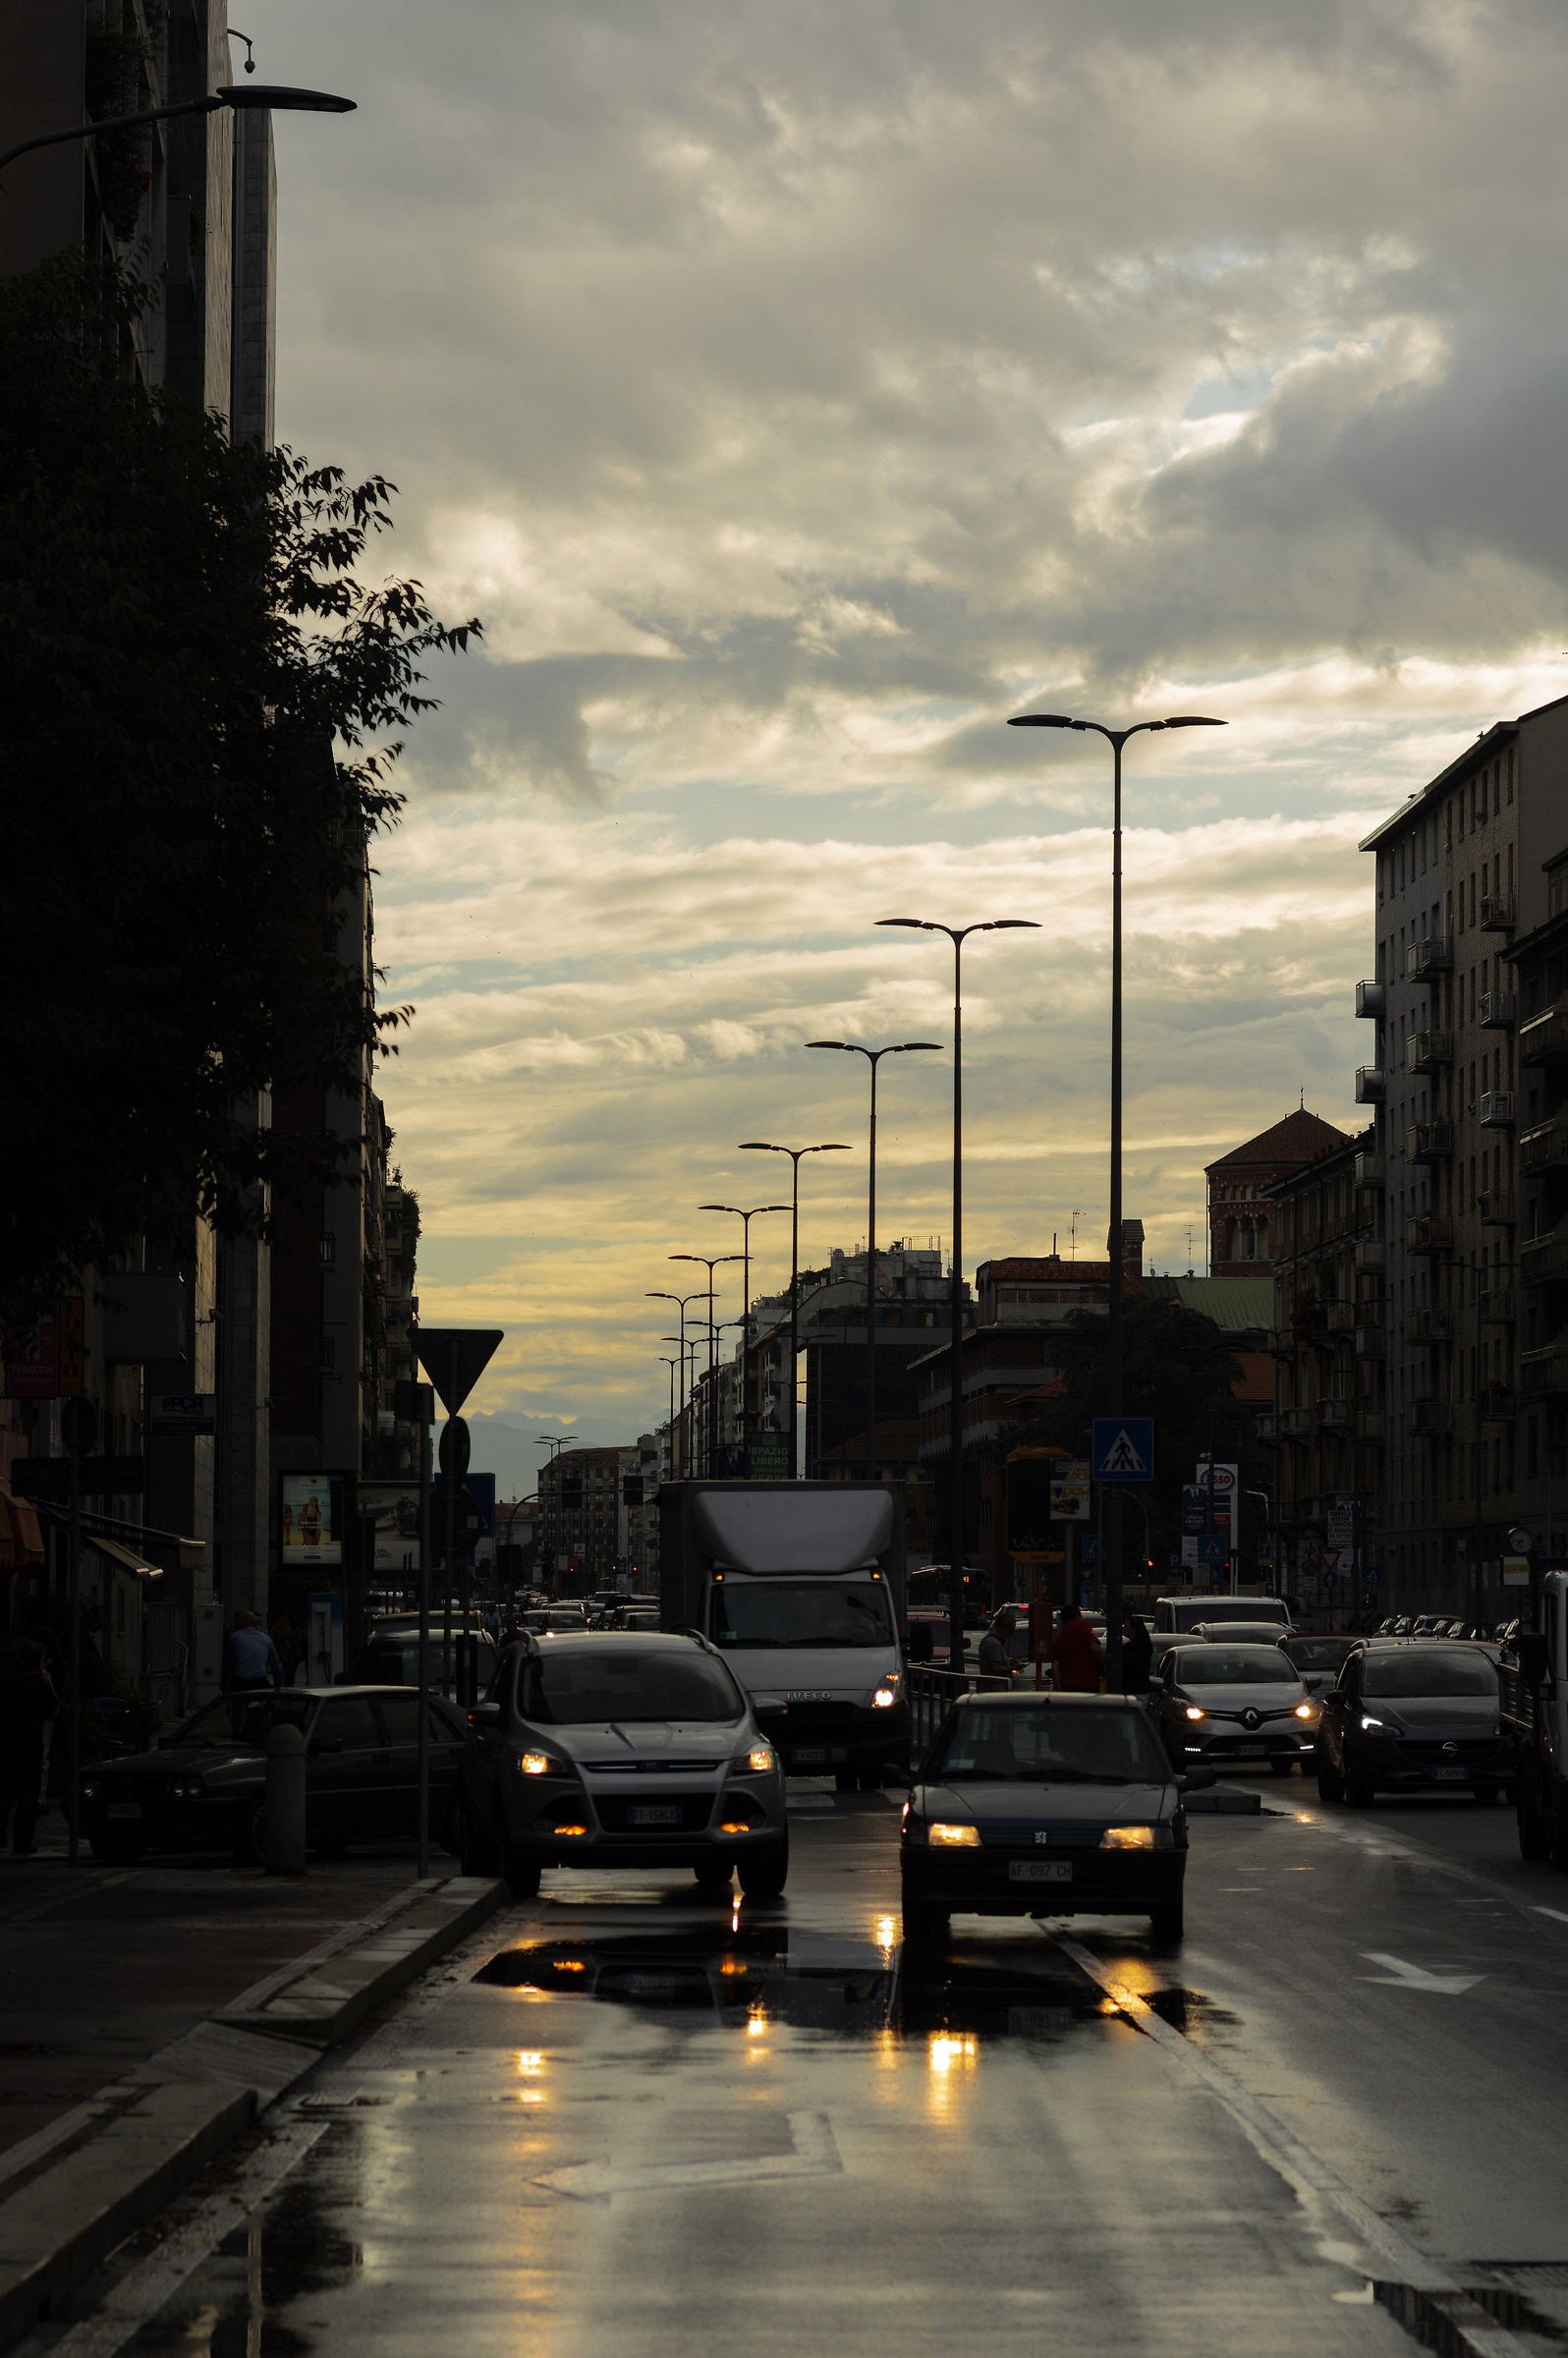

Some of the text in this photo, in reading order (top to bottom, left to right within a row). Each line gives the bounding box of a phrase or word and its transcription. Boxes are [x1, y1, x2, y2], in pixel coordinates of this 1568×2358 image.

[11, 1365, 55, 1374] TABACCHI
[751, 1446, 789, 1455] SPAZIO
[1170, 1554, 1180, 1566] P
[787, 1691, 832, 1701] IVECO
[1056, 1865, 1072, 1878] CH
